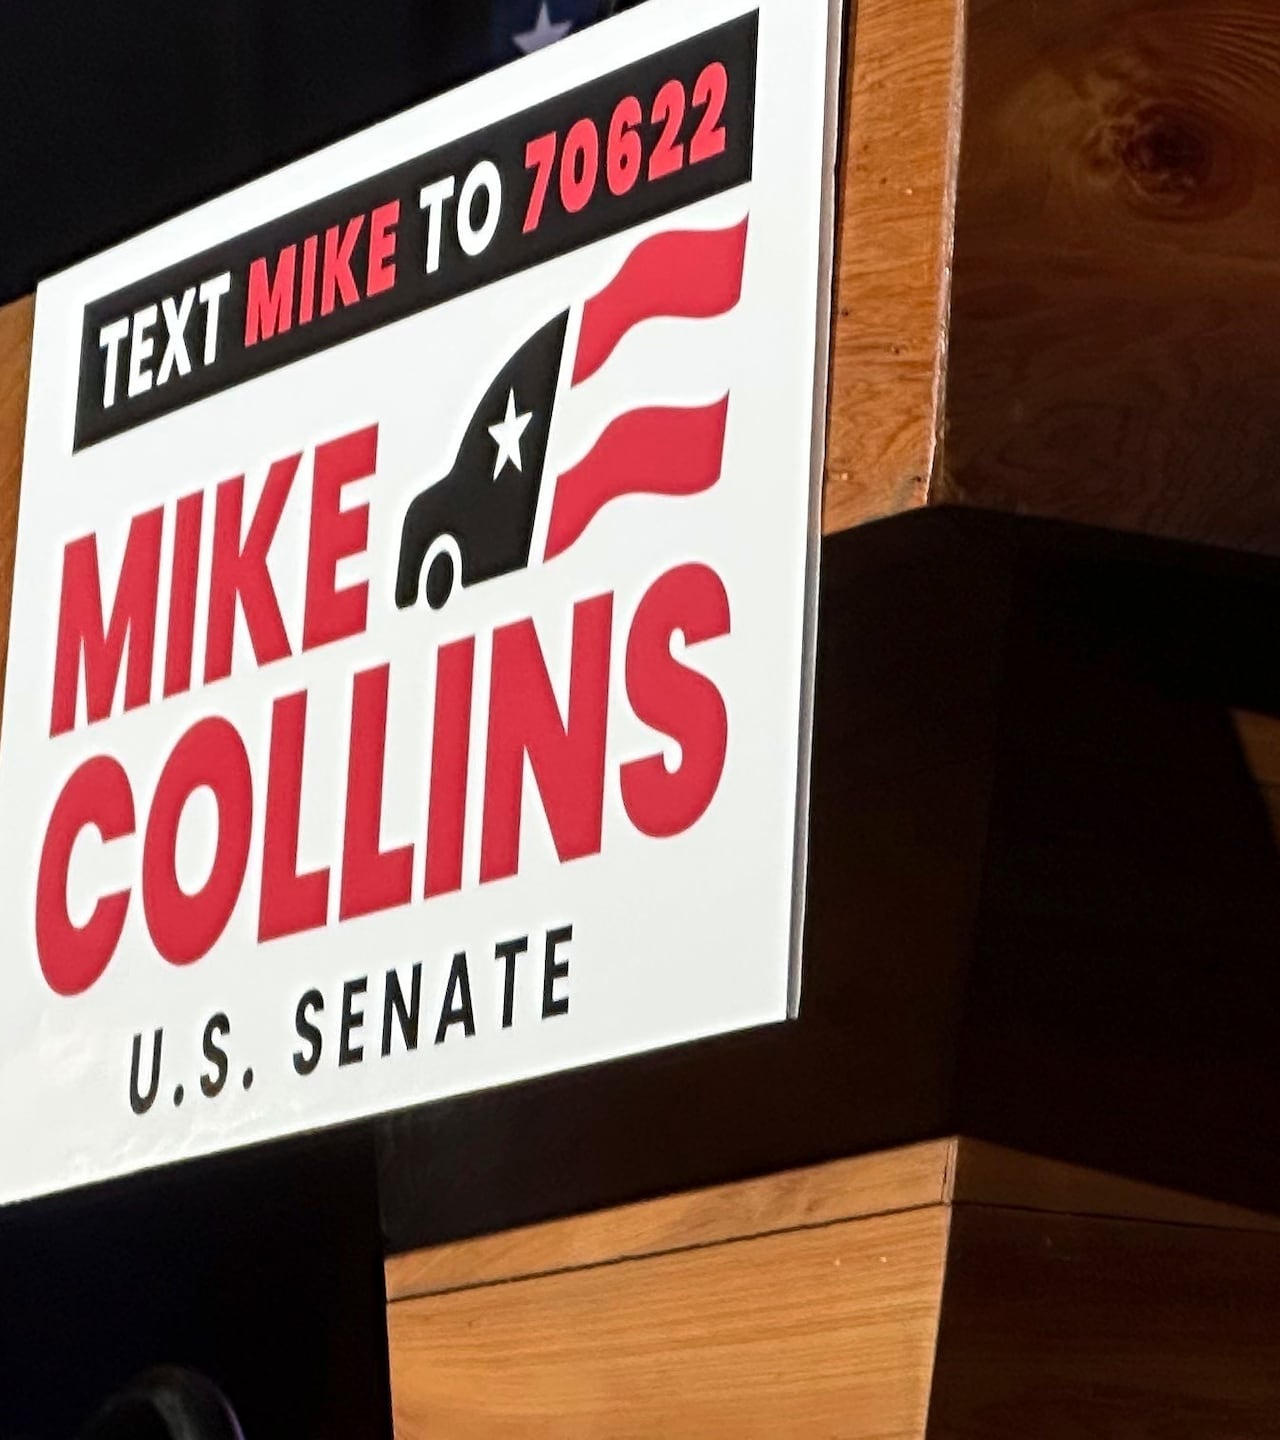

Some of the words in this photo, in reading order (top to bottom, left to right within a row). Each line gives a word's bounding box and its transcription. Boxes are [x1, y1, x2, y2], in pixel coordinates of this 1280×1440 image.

[97, 271, 232, 409] TEXT
[243, 200, 401, 348] MIKE
[418, 159, 503, 277] TO
[522, 61, 730, 234] 70622
[48, 422, 380, 740] MIKE
[34, 562, 732, 998] COLLINS
[128, 1012, 255, 1115] U.S.
[292, 924, 574, 1077] SENATE
